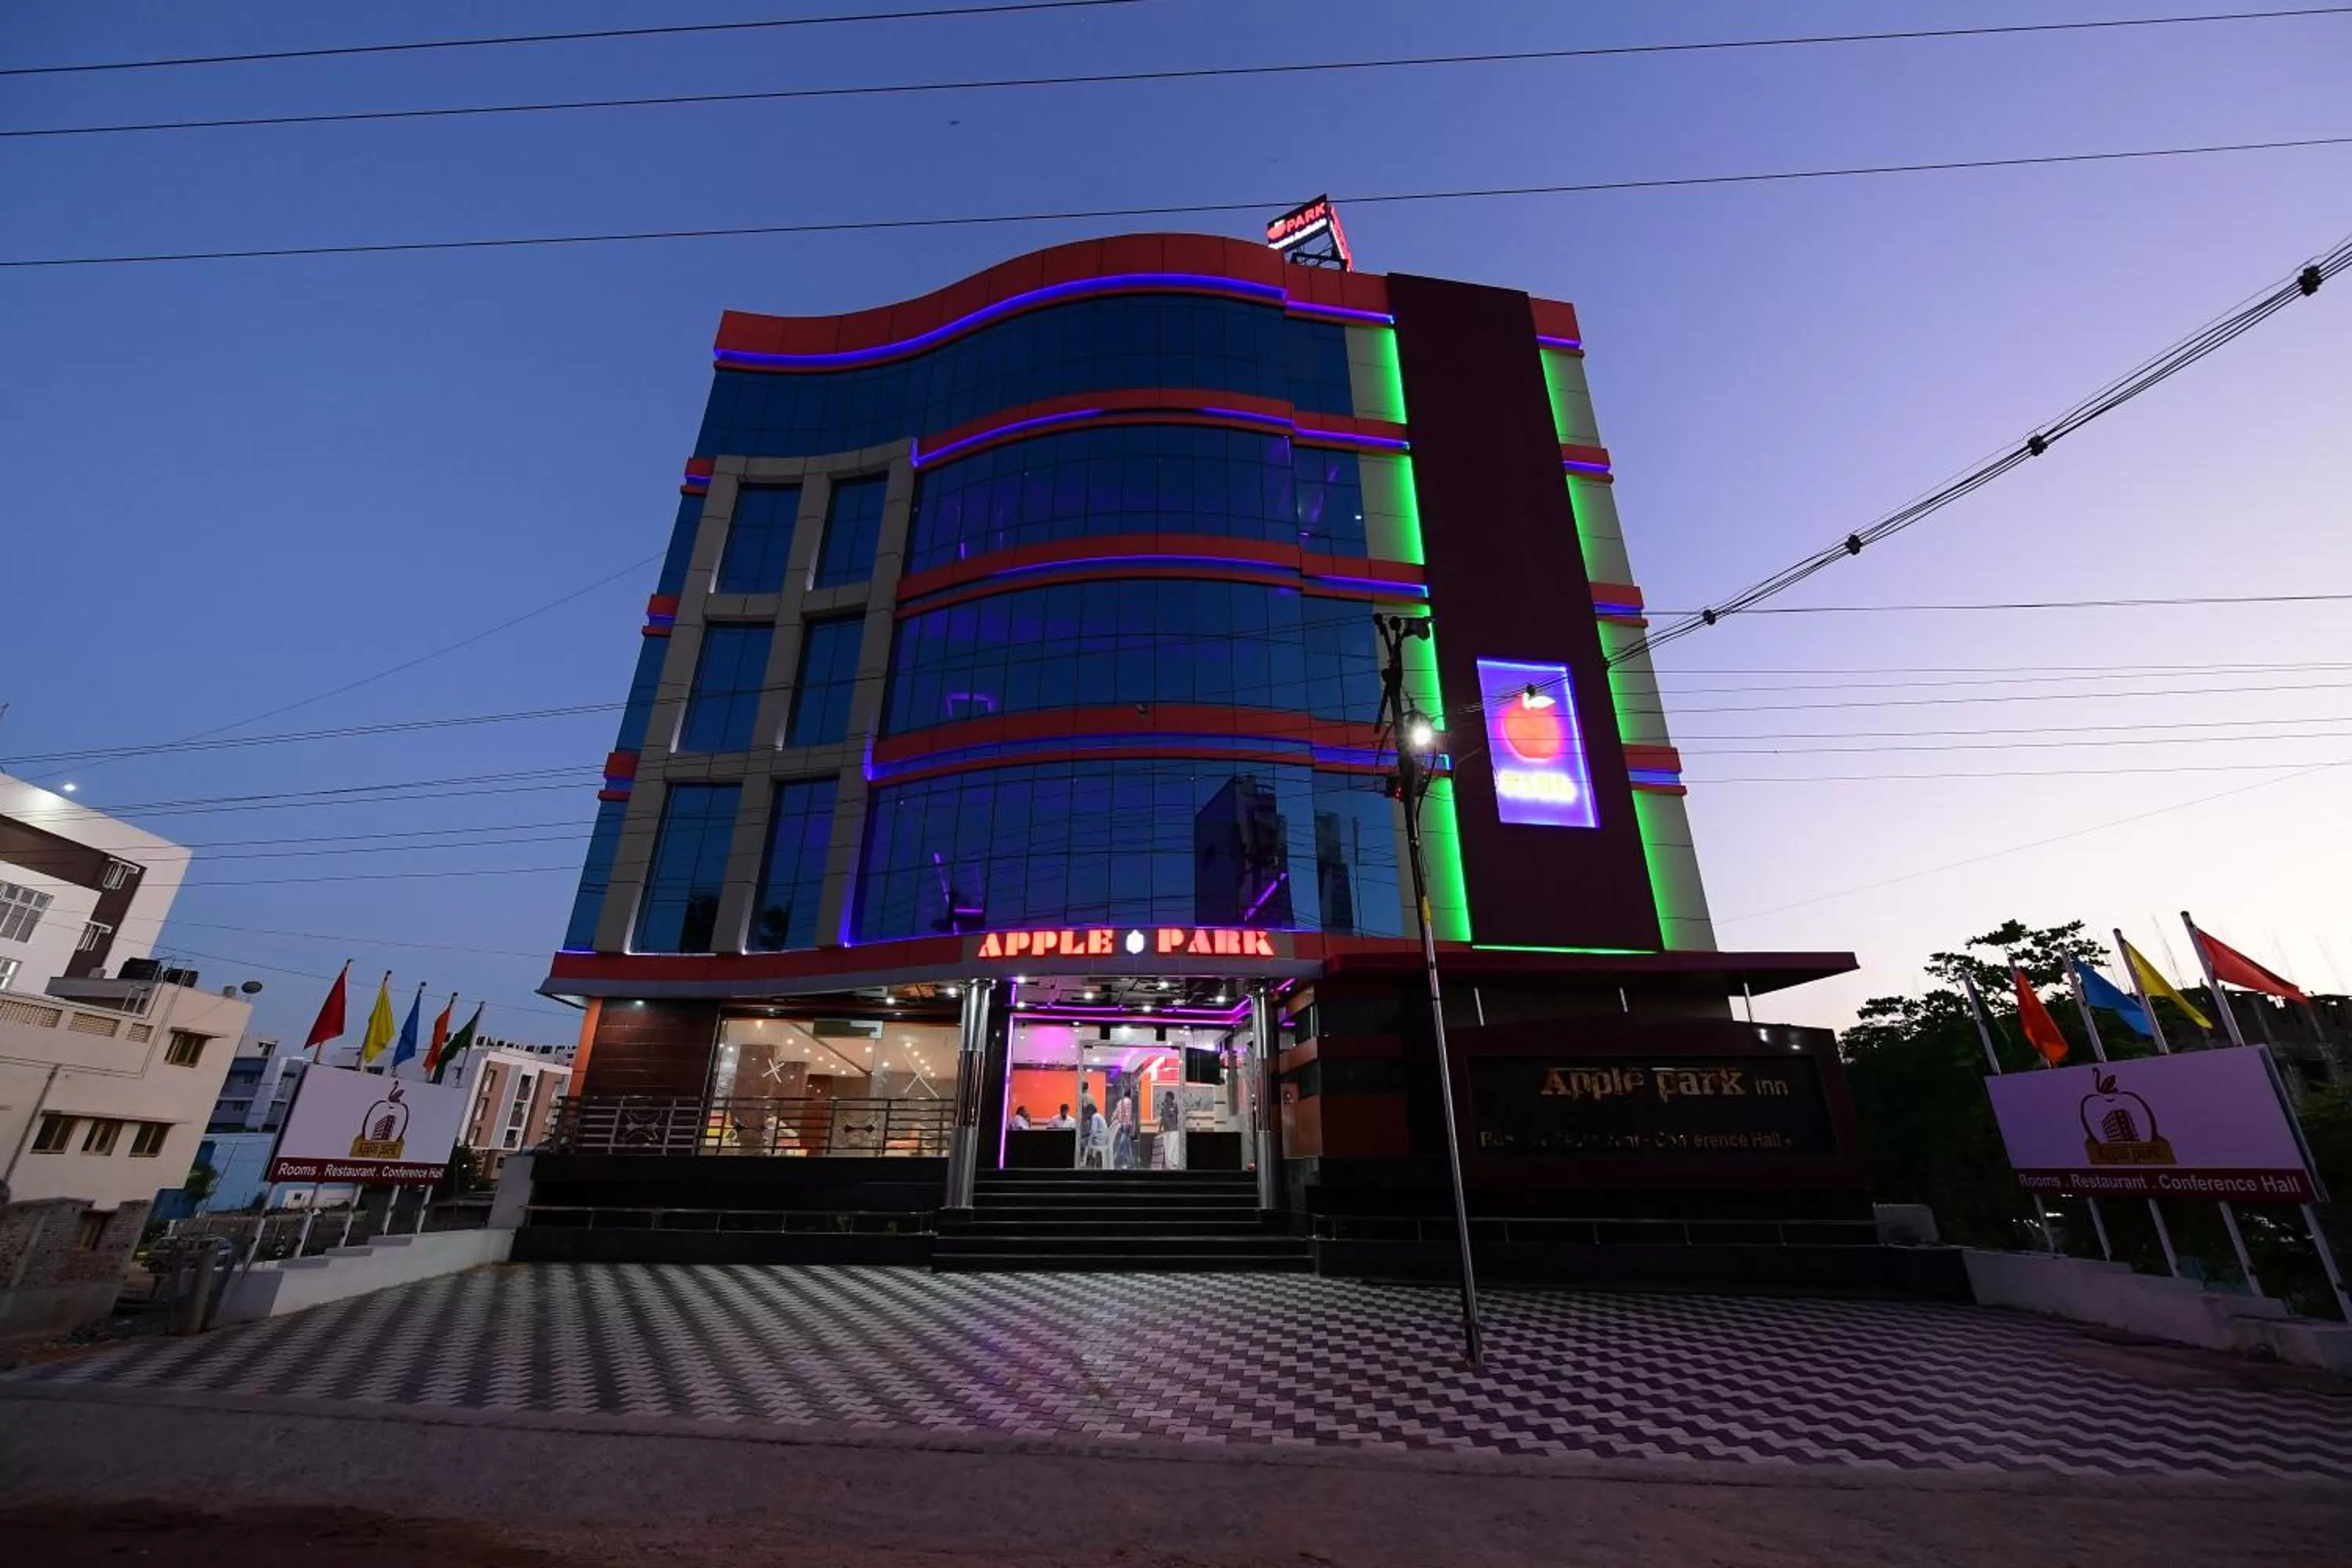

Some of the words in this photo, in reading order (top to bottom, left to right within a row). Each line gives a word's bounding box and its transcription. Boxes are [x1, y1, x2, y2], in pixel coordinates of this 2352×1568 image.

[1286, 202, 1326, 233] PARK
[978, 929, 1113, 956] APPLE
[1157, 928, 1274, 956] PARK
[1541, 1067, 1645, 1103] Apple
[278, 1163, 317, 1177] Rooms
[324, 1164, 376, 1178] Restaurant
[382, 1166, 428, 1179] Conference
[428, 1168, 445, 1178] Hall
[2018, 1174, 2062, 1189] Rooms
[2071, 1174, 2148, 1190] Restaurant
[2158, 1174, 2257, 1192] Conference
[2262, 1176, 2302, 1194] Hall
